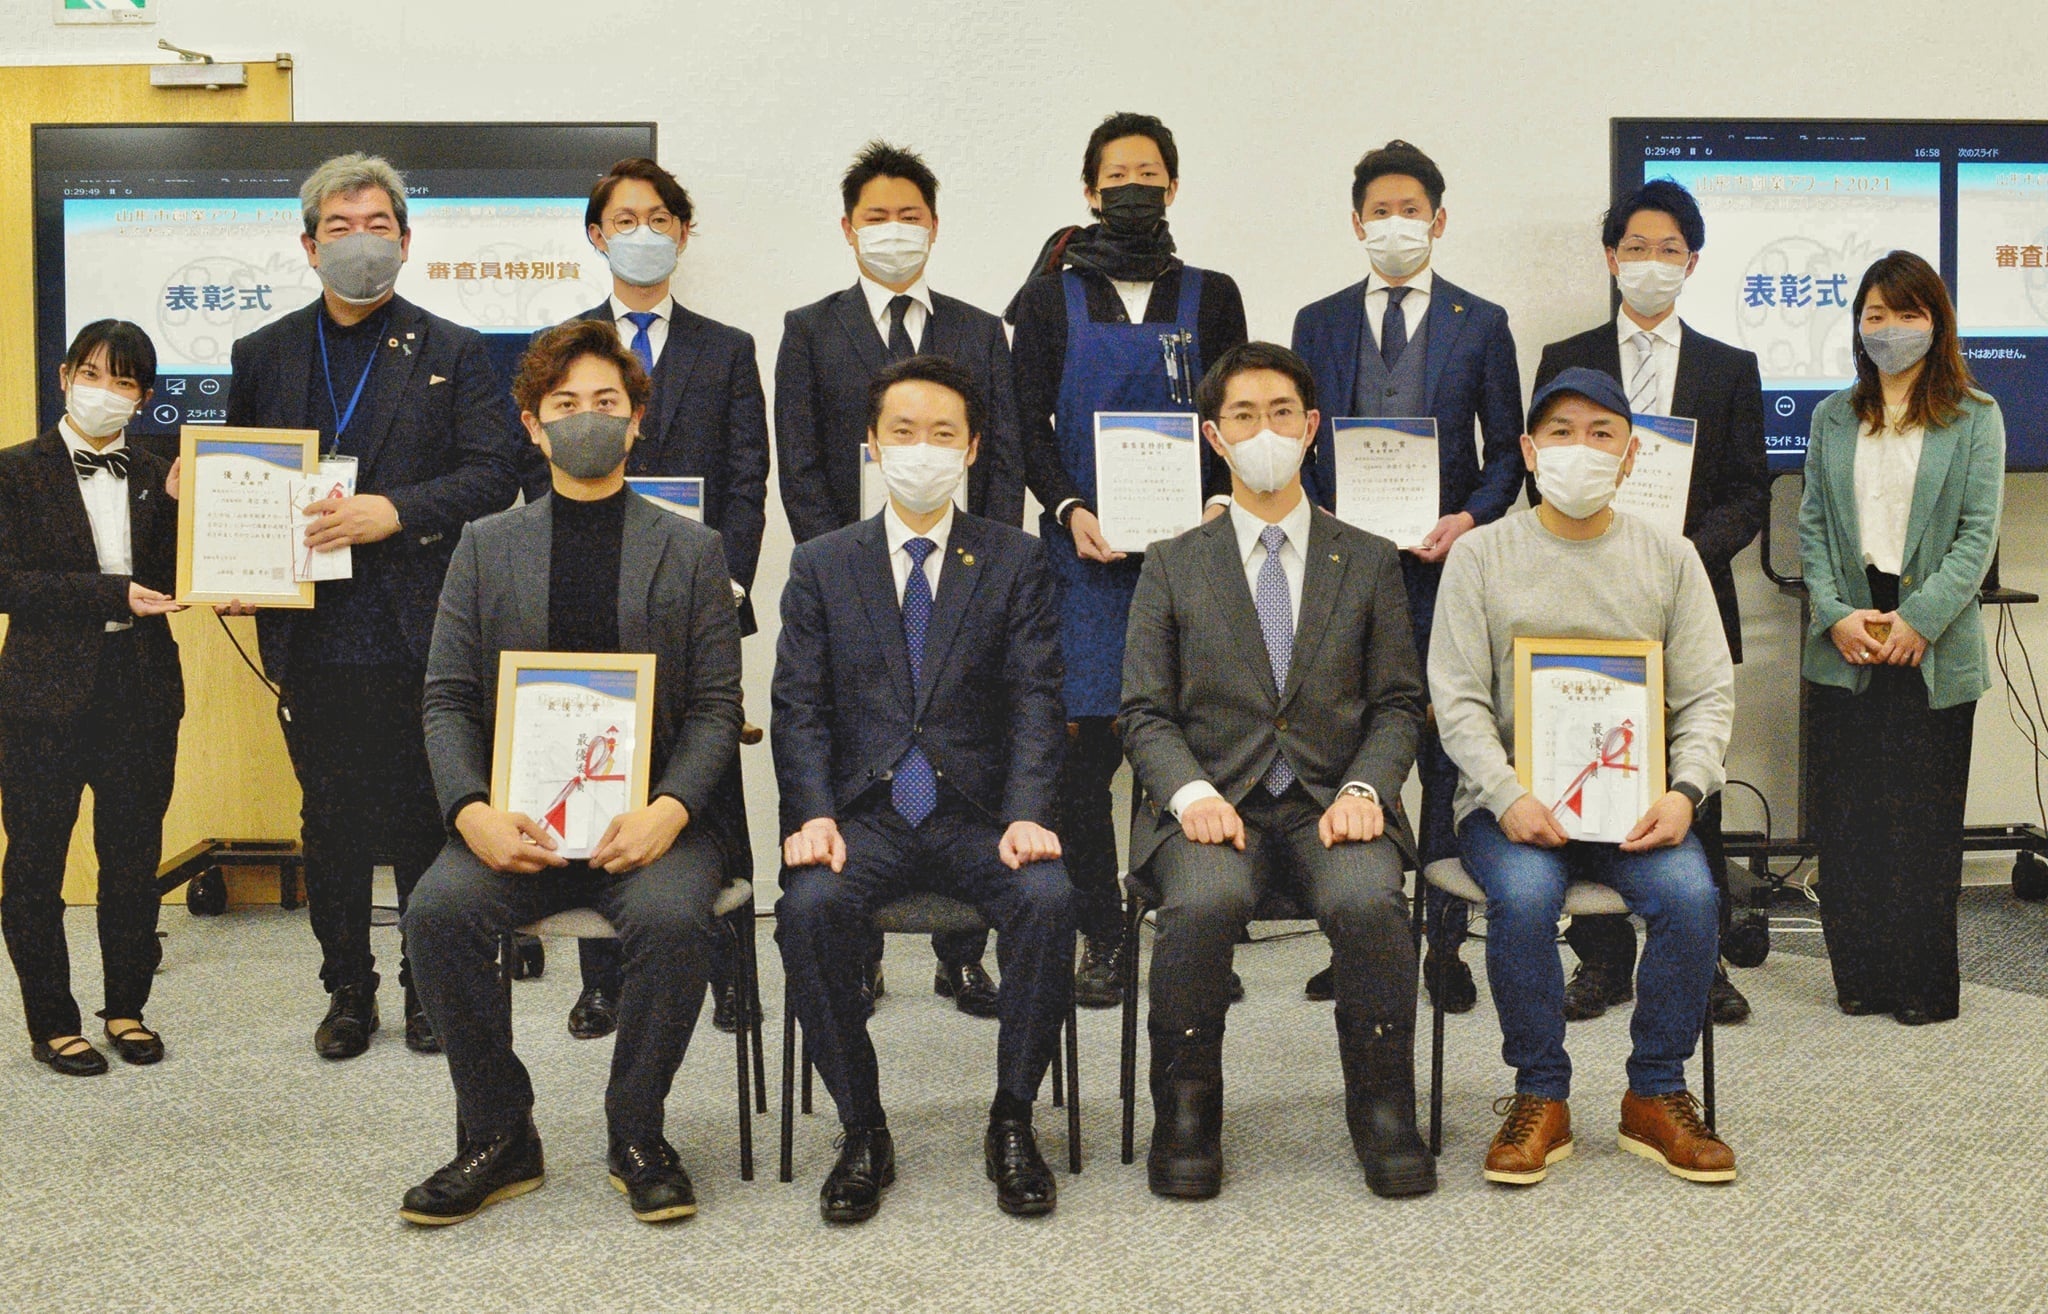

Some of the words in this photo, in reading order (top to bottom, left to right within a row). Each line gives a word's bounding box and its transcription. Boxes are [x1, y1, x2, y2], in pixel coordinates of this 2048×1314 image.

[1645, 147, 1681, 156] 0:29:49
[1915, 148, 1940, 157] 16:58
[1958, 148, 1999, 157] 次のスライド
[64, 188, 100, 196] 0:29:49
[1995, 244, 2048, 267] 審査
[427, 261, 581, 280] 審査員特別賞
[1743, 273, 1848, 307] 表彰式
[165, 284, 272, 311] 表彰式
[1957, 348, 2027, 359] ートはありません。
[187, 409, 217, 418] スライド
[1764, 435, 1792, 446] スライド
